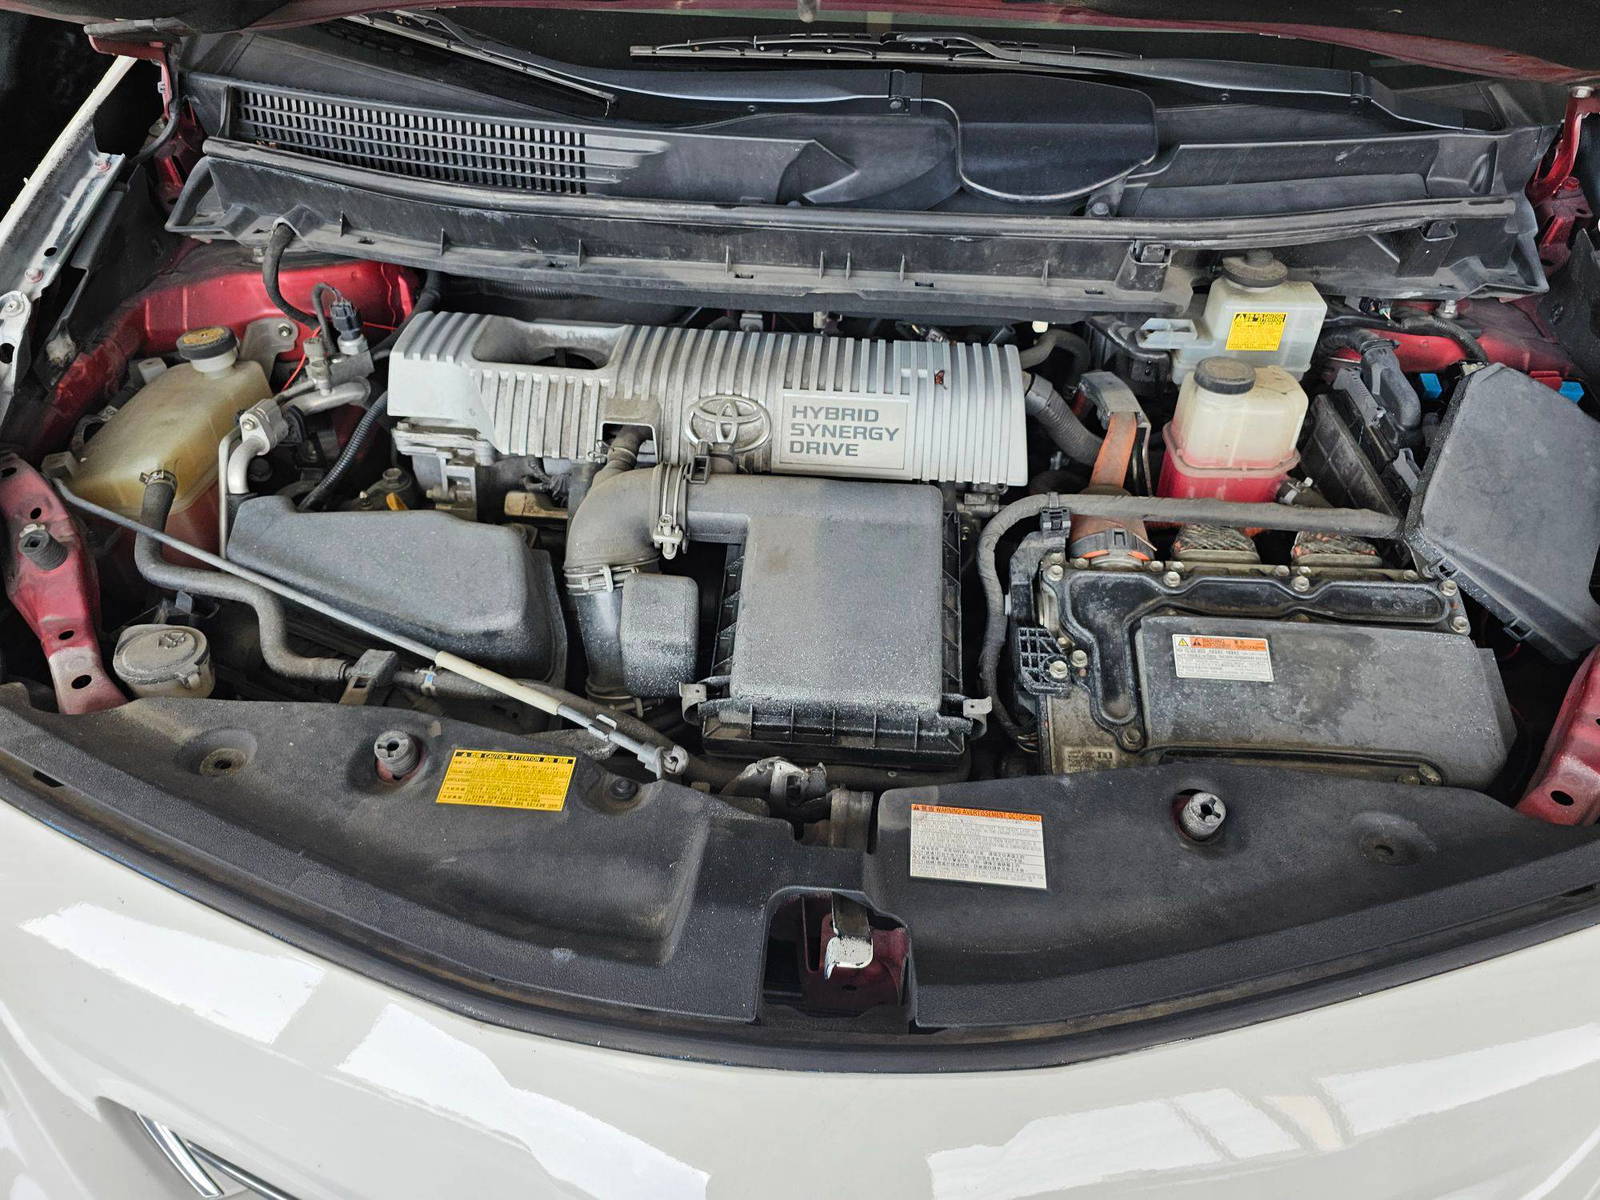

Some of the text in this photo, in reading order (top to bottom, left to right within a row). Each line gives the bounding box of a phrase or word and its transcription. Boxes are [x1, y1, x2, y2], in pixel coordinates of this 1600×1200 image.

[792, 405, 880, 422] HYBRID
[790, 423, 899, 441] SYNERGY
[790, 441, 860, 457] DRIVE
